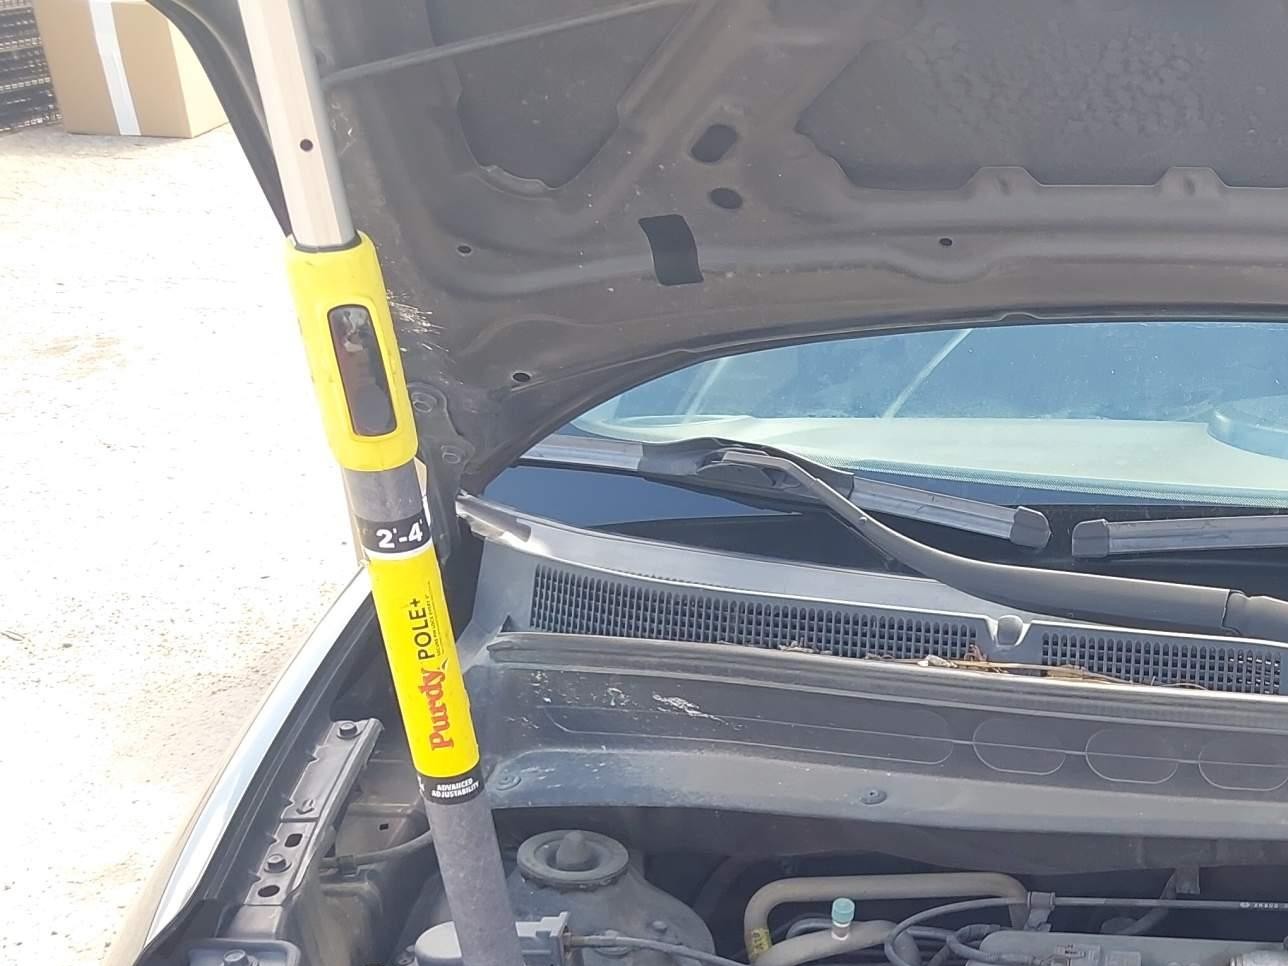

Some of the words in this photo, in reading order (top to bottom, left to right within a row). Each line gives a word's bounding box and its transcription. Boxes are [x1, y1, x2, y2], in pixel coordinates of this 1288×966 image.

[408, 598, 435, 660] POLE+
[418, 668, 454, 751] Purdy
[432, 781, 480, 798] ADJUSTABILITY
[437, 778, 473, 791] ADVANCED
